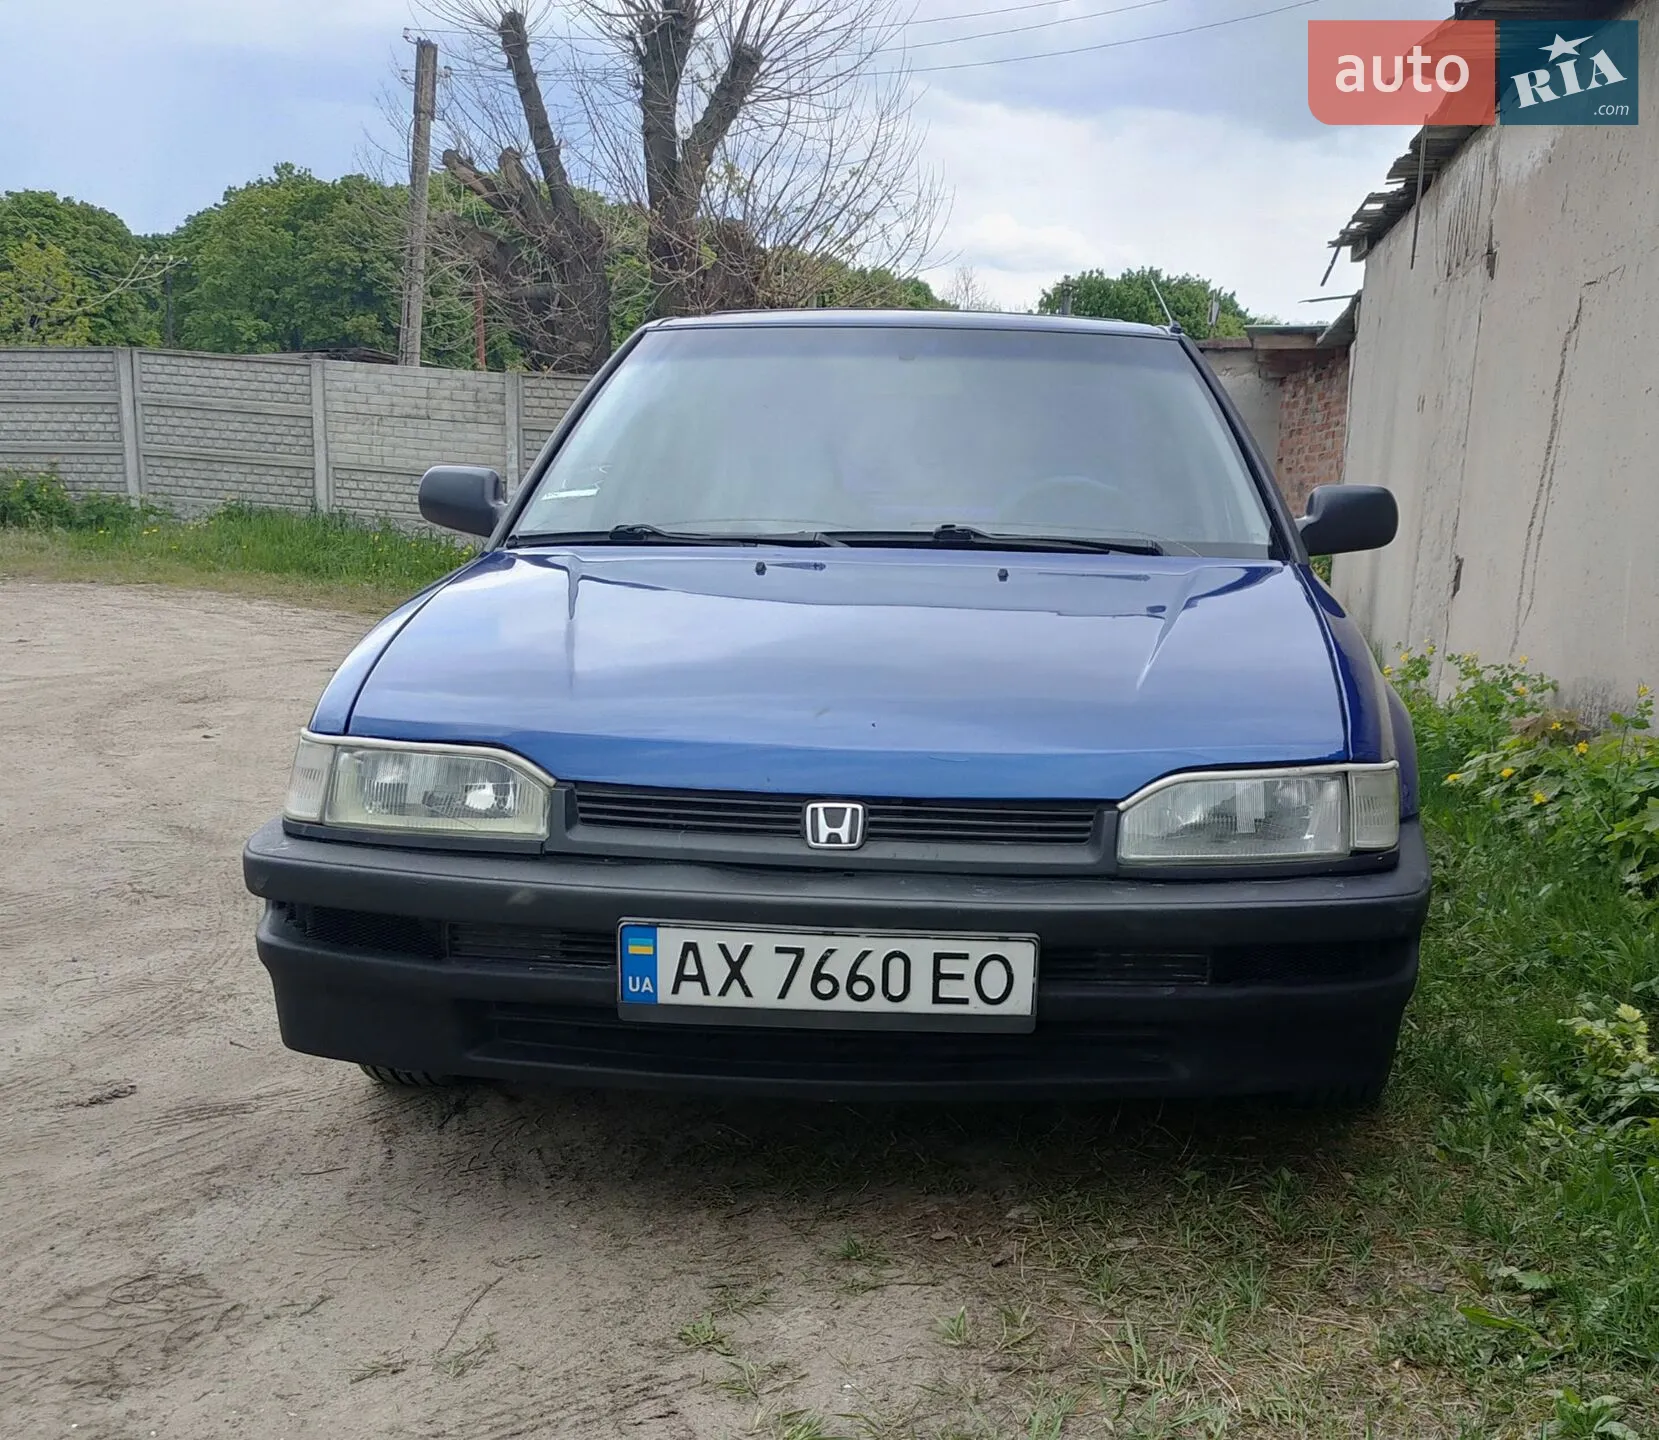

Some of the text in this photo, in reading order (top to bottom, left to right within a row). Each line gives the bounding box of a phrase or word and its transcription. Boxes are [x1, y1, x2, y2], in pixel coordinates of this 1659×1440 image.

[628, 975, 654, 994] UA
[671, 941, 1015, 1006] AX 7660 EO
